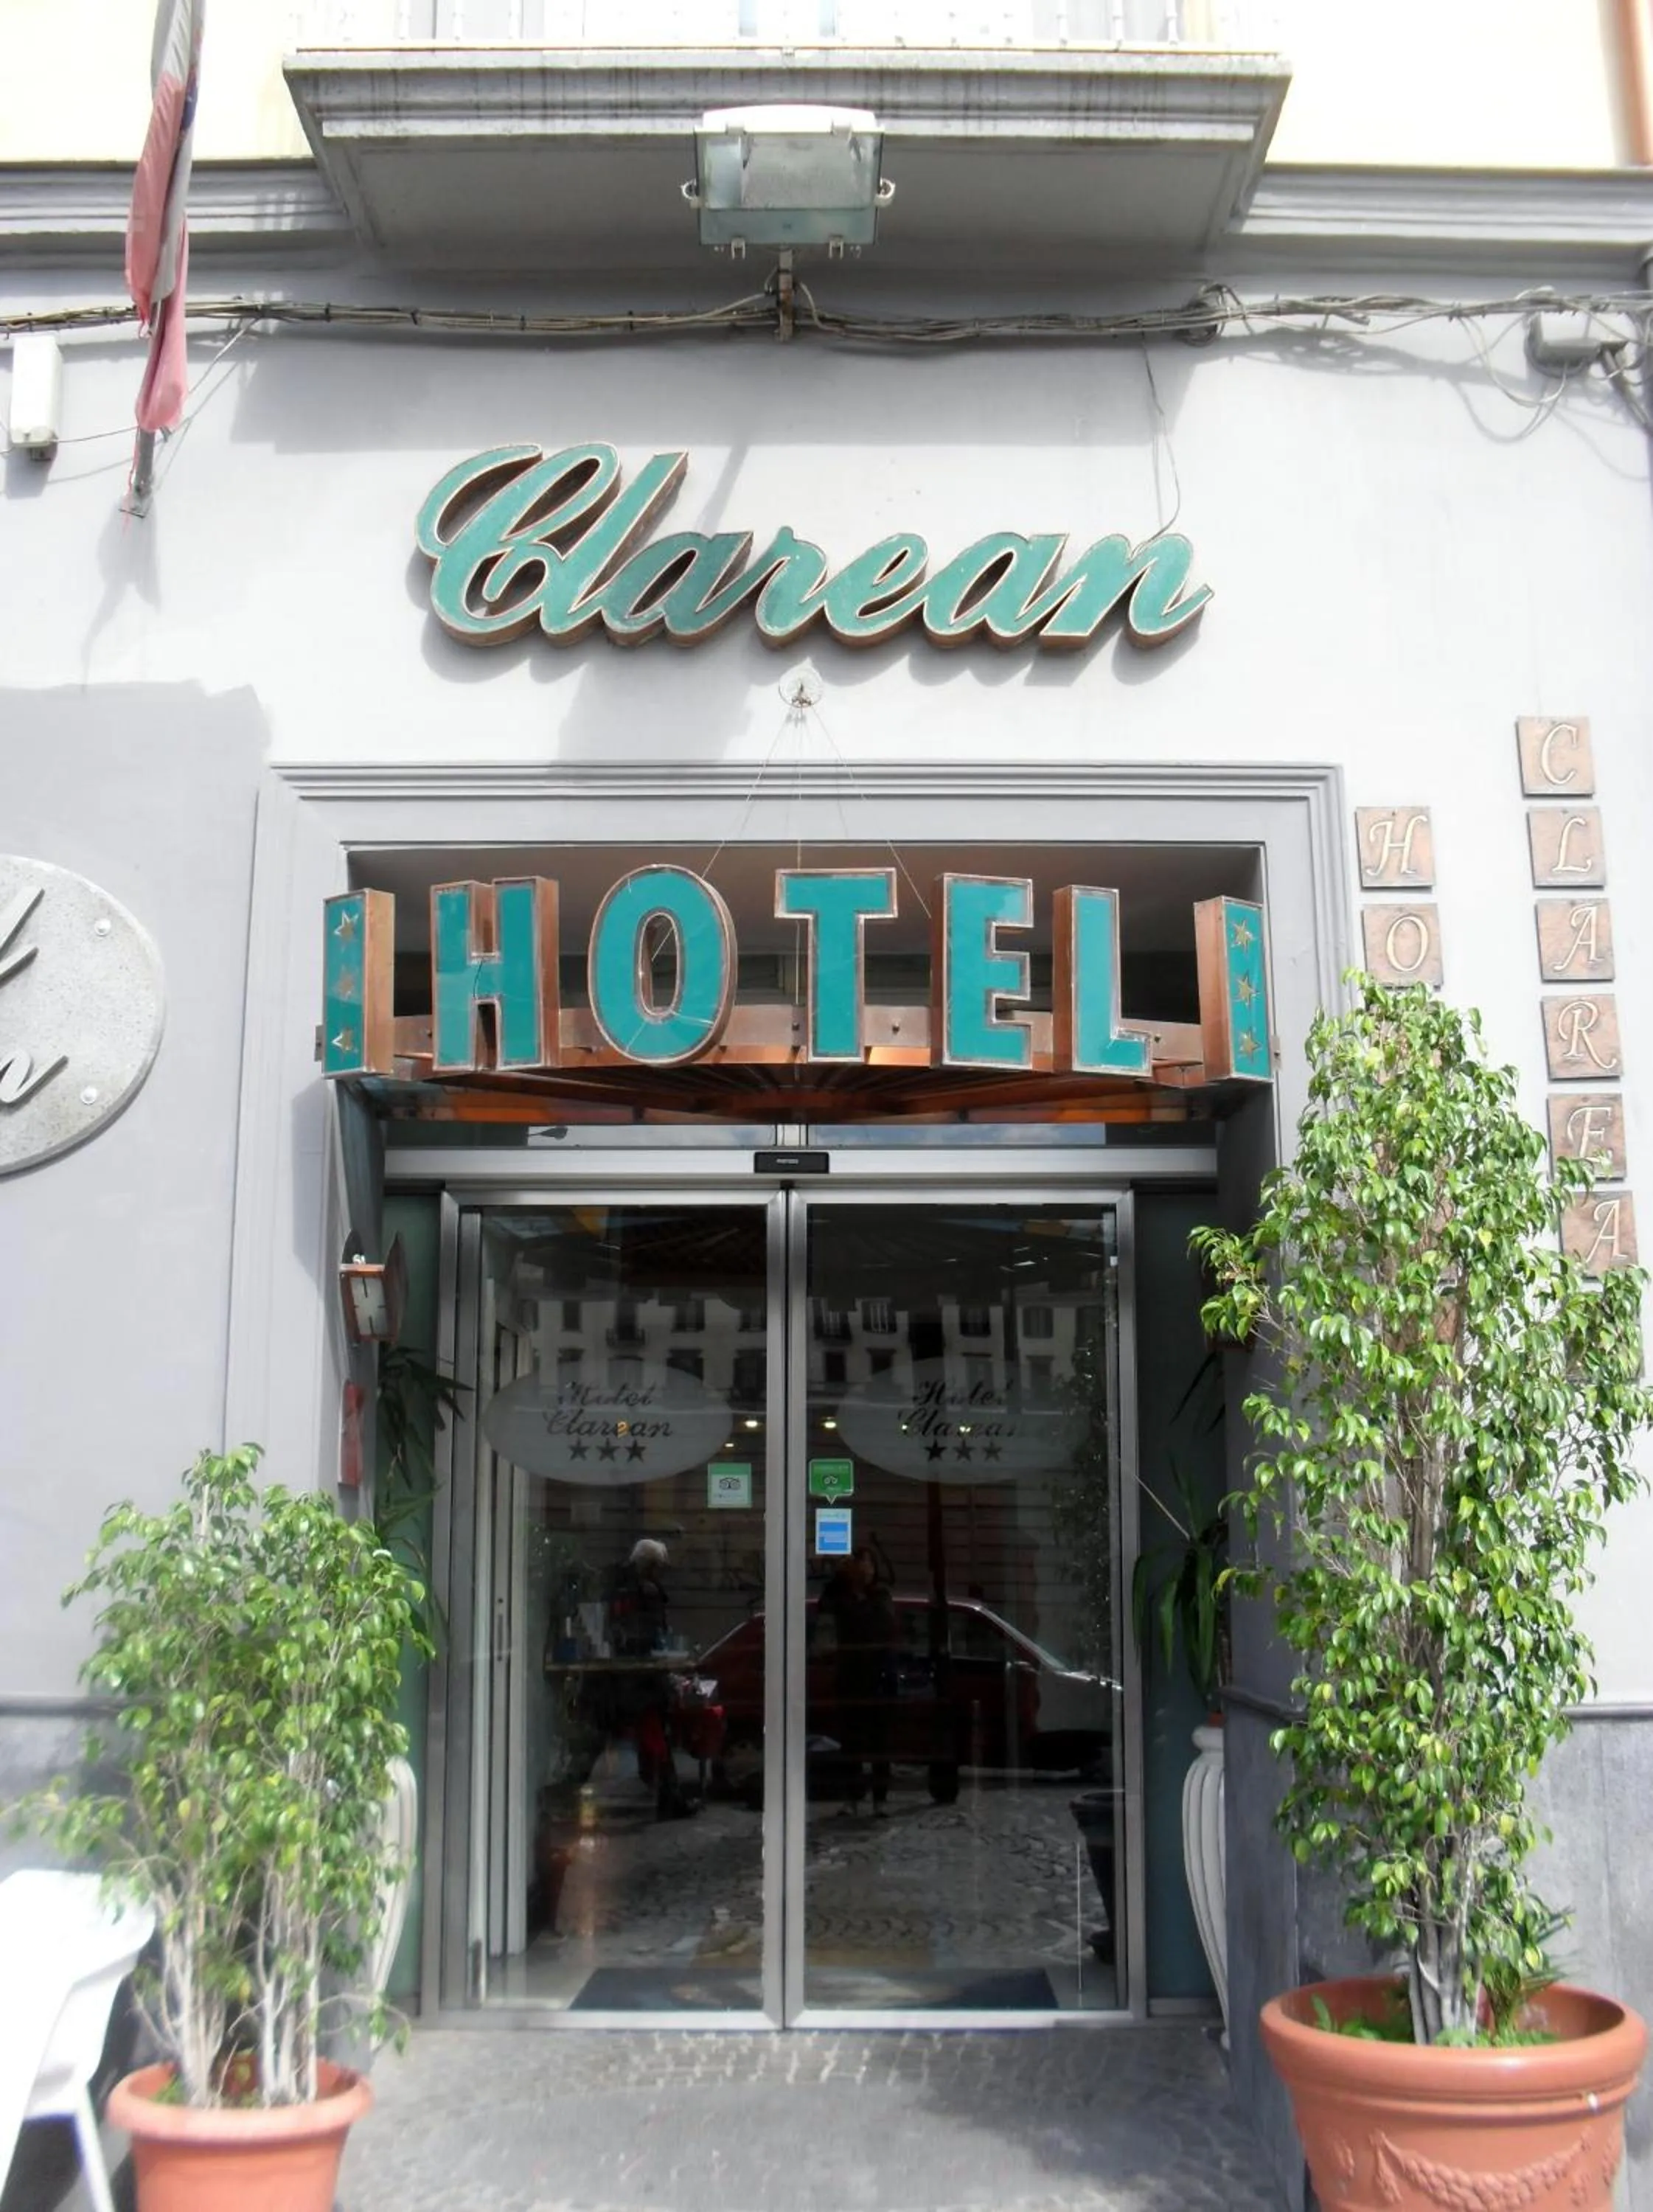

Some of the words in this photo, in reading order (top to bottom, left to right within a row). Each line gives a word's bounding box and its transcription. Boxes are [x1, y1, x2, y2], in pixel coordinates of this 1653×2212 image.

[414, 441, 1214, 650] Clarean
[429, 863, 1152, 1078] HOTEL
[897, 1407, 1017, 1438] Claea
